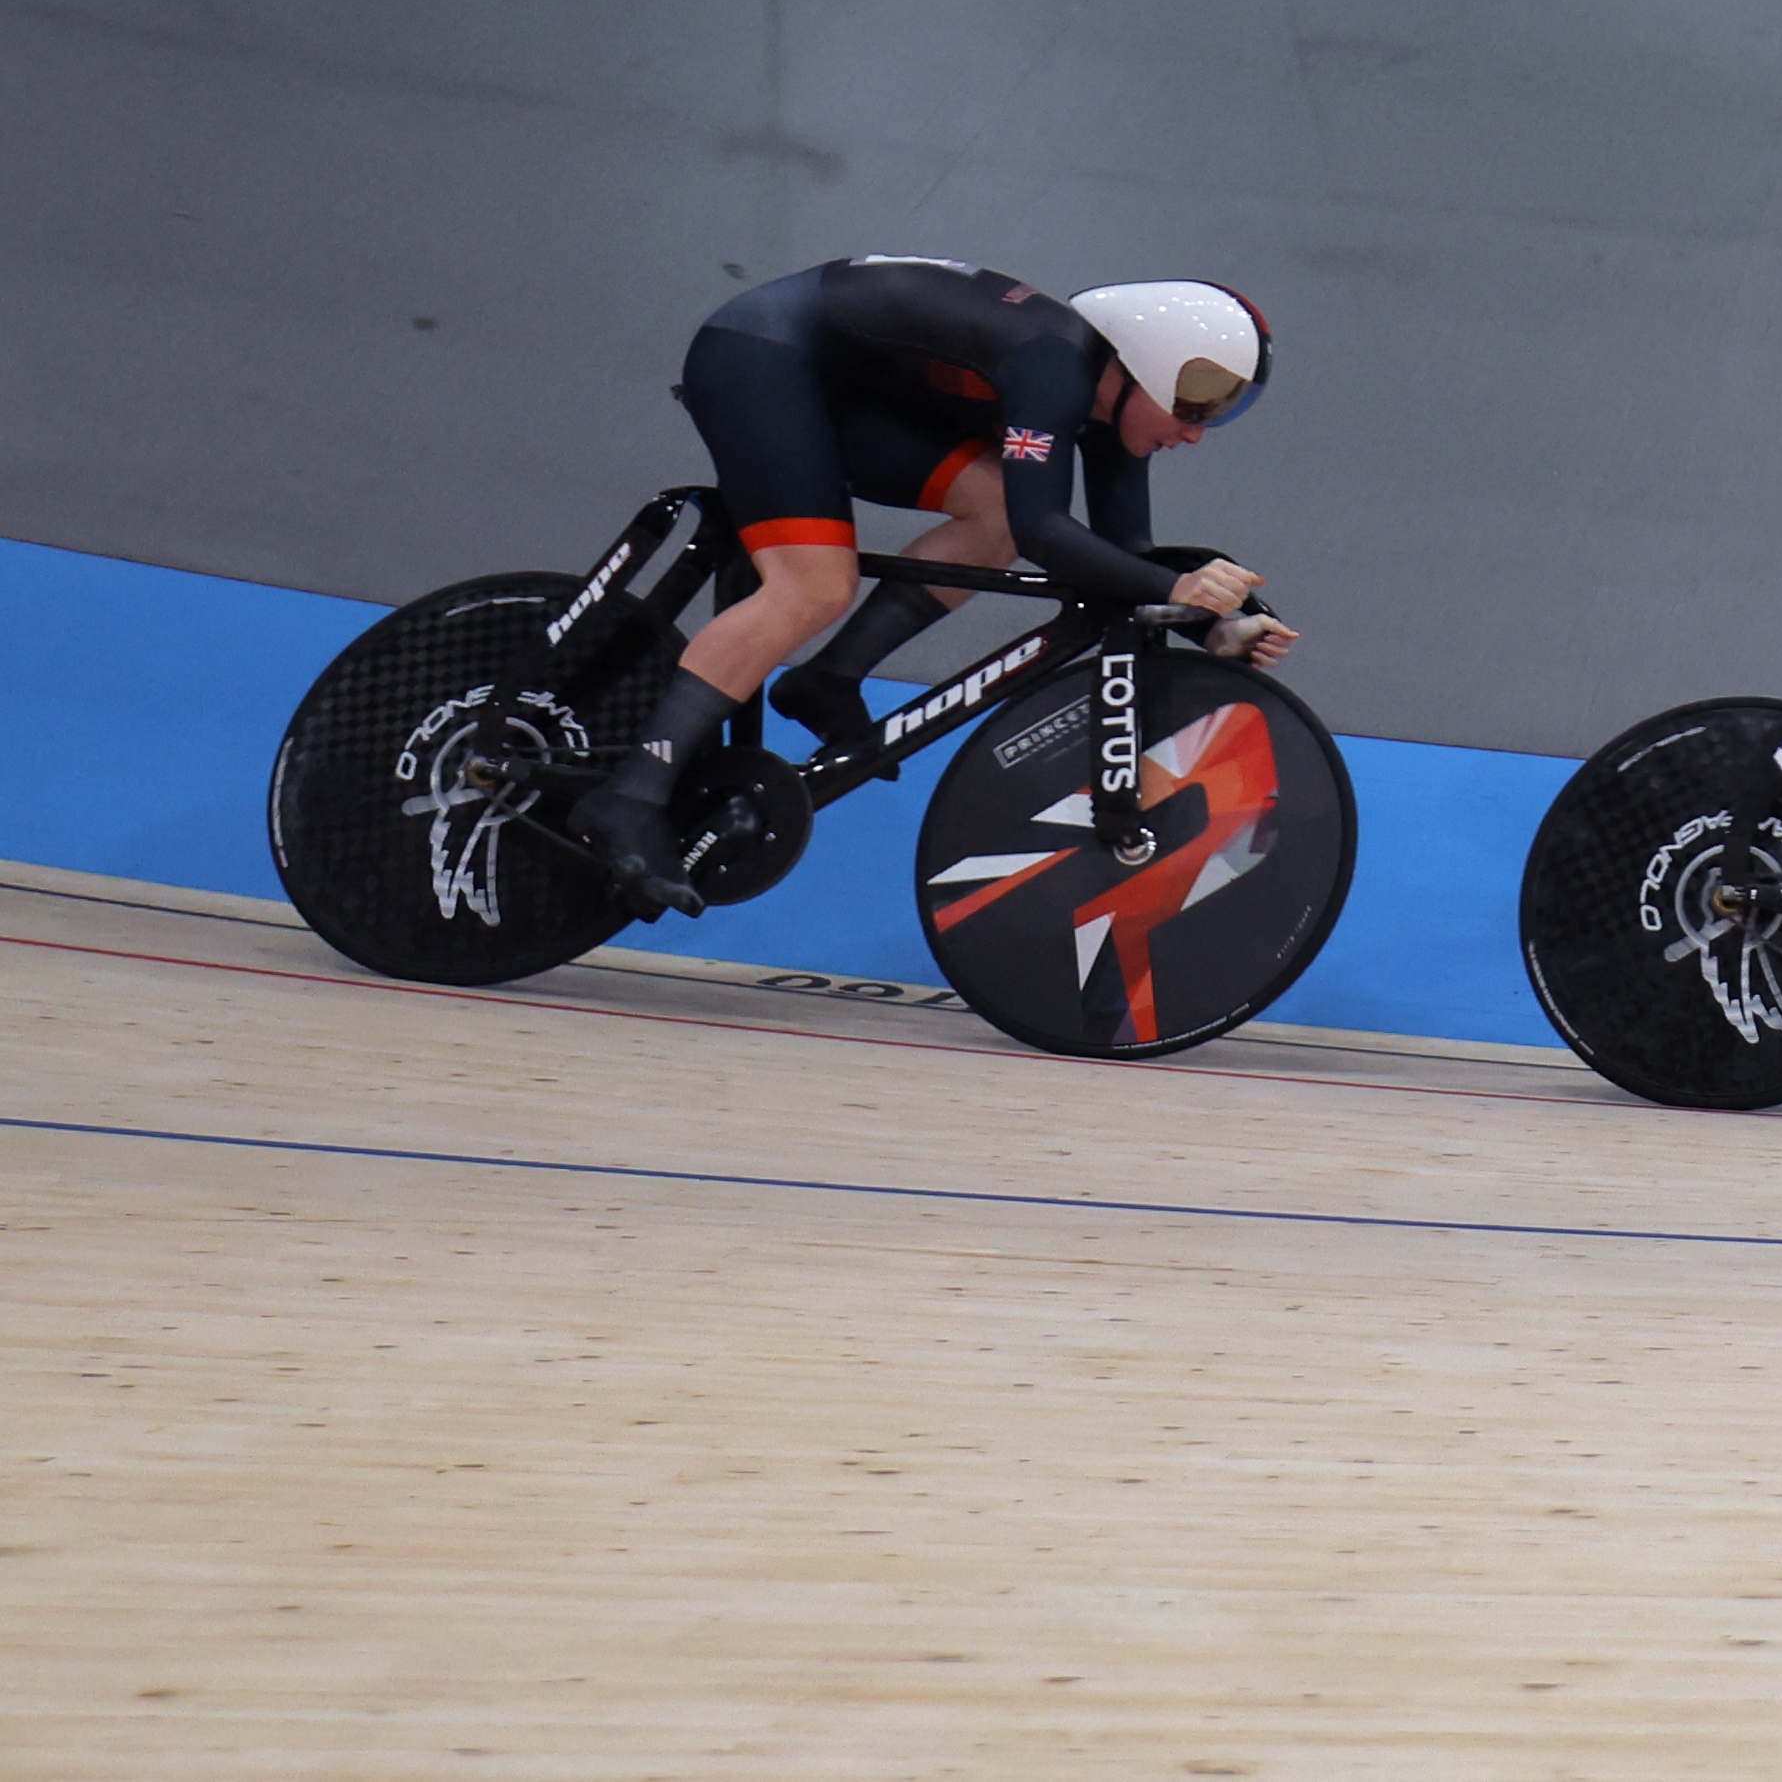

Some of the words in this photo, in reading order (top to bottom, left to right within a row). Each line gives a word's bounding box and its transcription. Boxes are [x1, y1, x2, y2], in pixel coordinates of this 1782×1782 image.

[546, 541, 632, 646] hope
[884, 636, 1043, 746] hope
[1101, 653, 1136, 793] LOTUS
